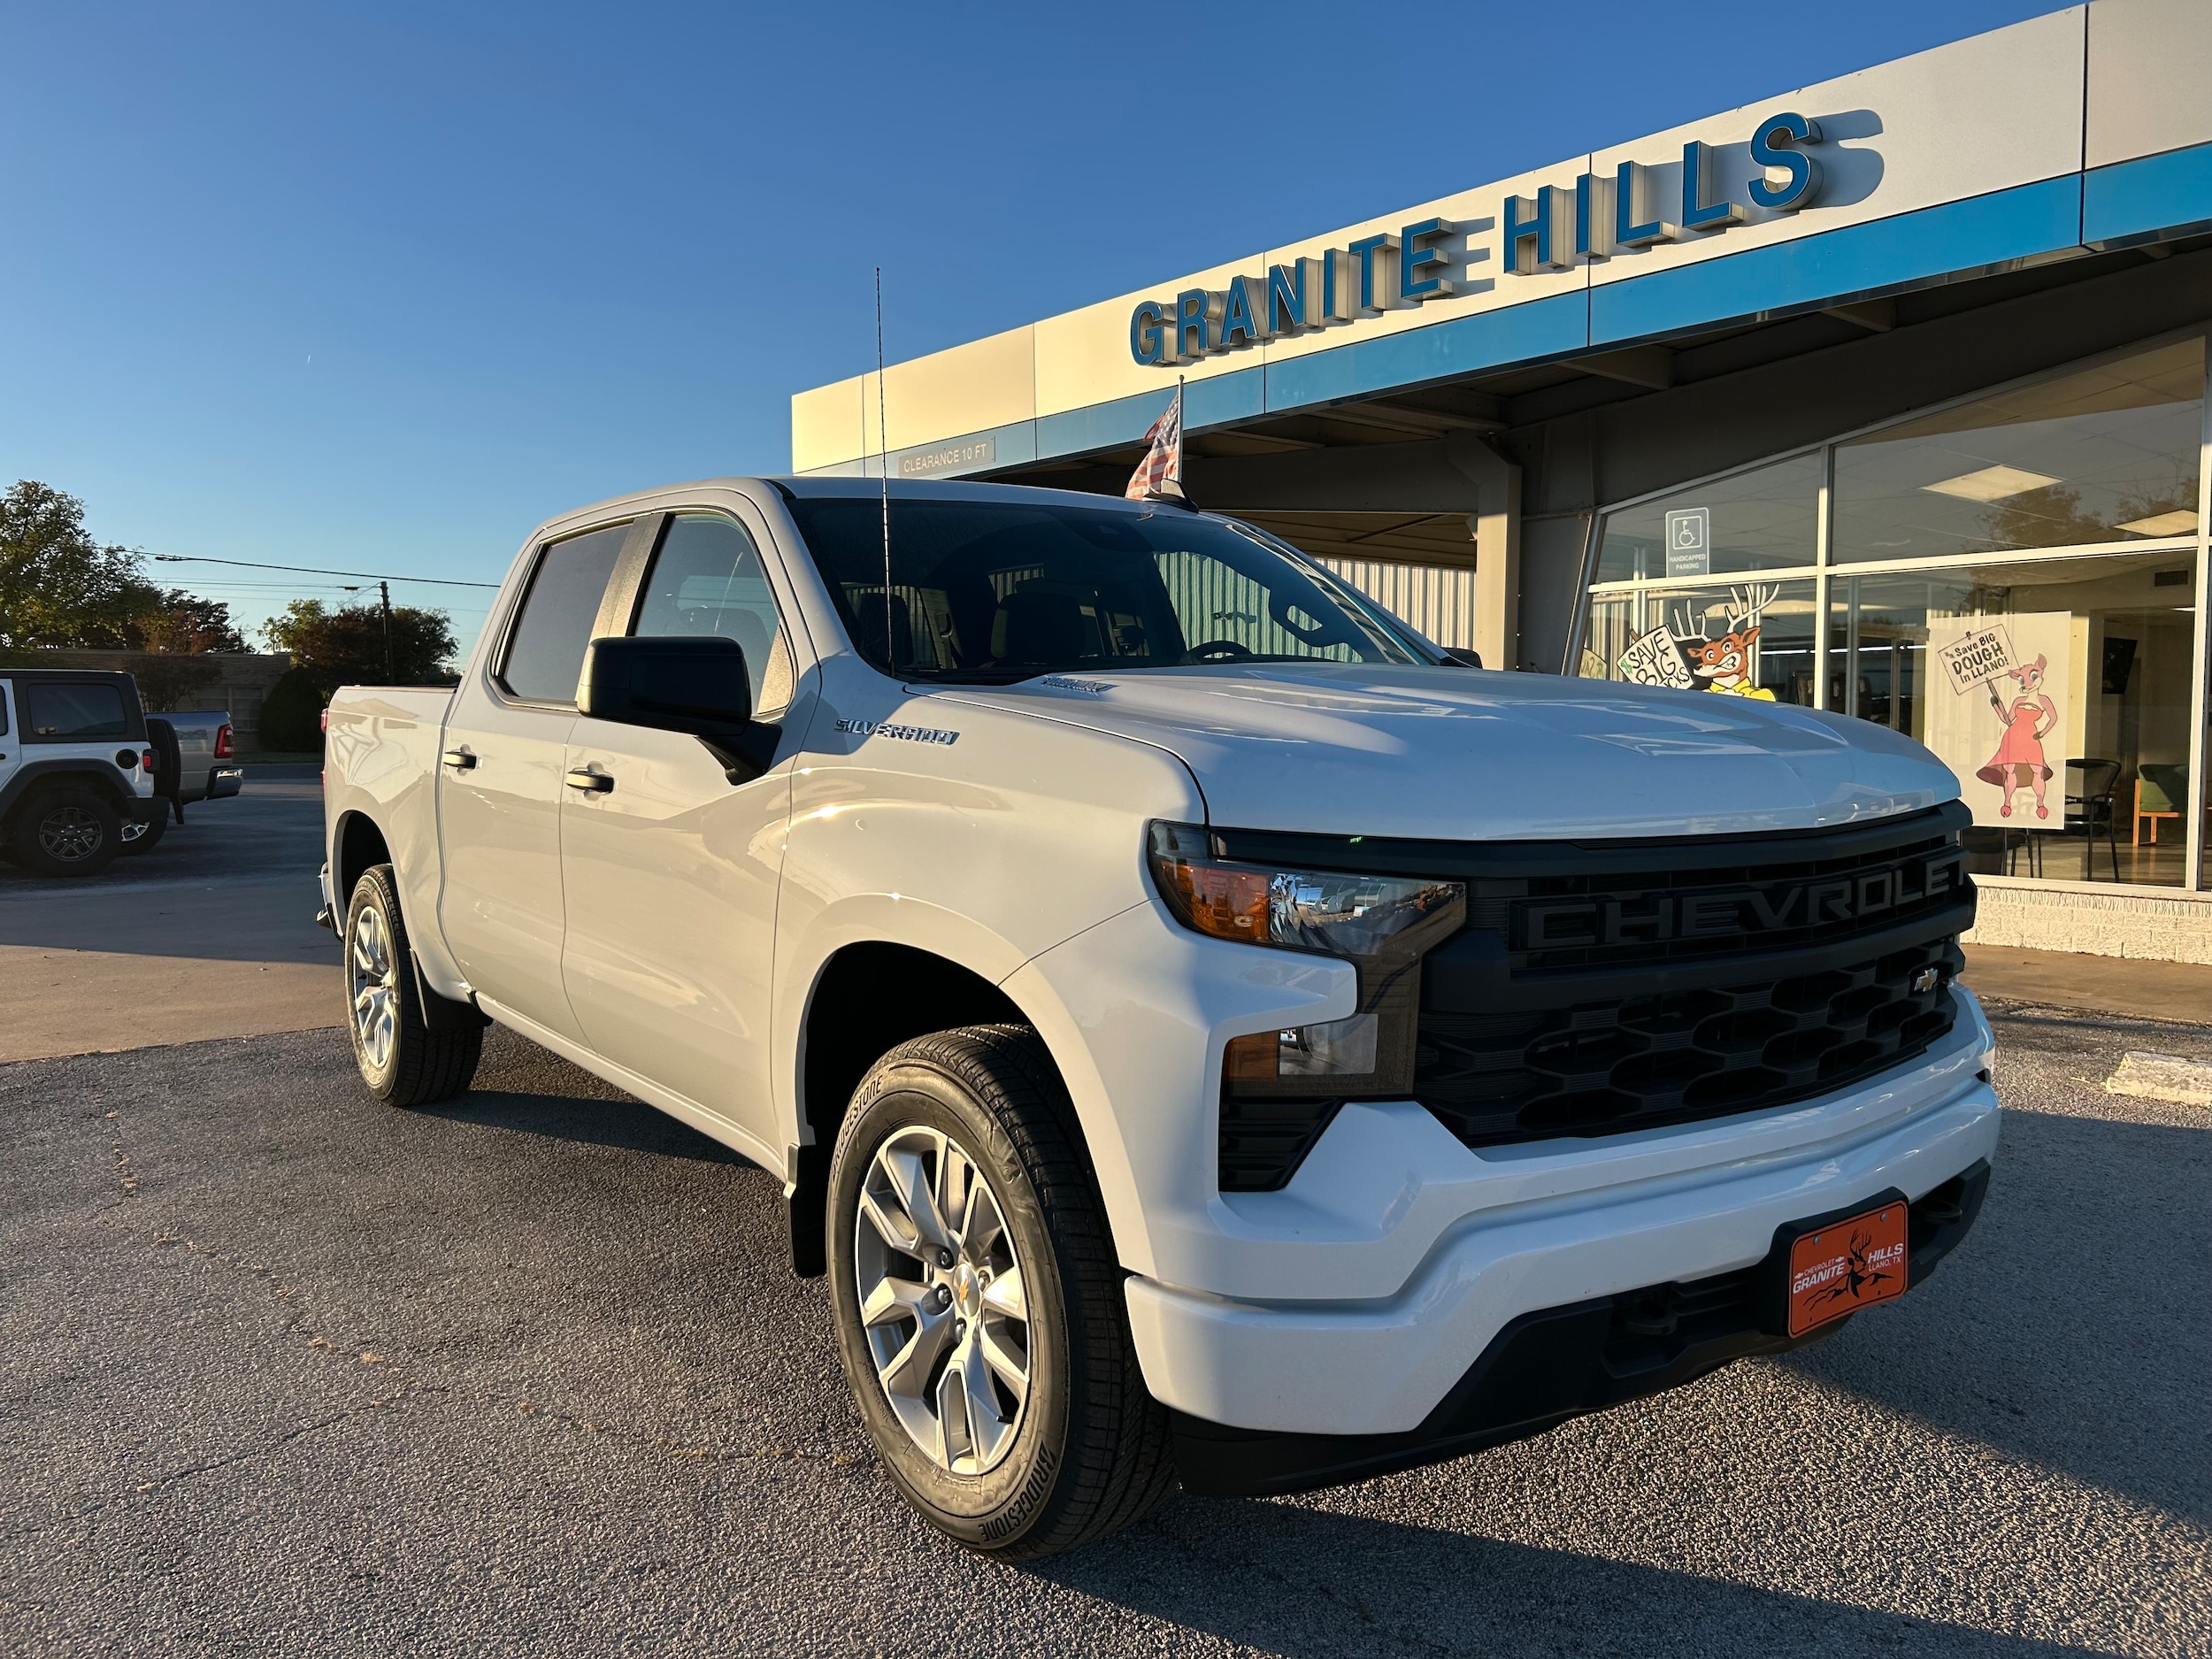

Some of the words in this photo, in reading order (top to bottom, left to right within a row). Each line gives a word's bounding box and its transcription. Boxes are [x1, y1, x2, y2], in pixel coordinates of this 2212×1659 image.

[1131, 218, 1448, 366] GRANITE
[1504, 111, 1819, 274] HILLS
[903, 449, 959, 472] CLEARANCE
[962, 447, 972, 461] 10
[975, 443, 987, 458] FT
[1669, 553, 1706, 563] HANDICAPPED
[1629, 631, 1670, 668] SAVE
[1952, 641, 2004, 675] DOUGH
[1955, 642, 1978, 657] Save
[1978, 633, 1996, 646] BIG
[1635, 652, 1676, 686] BIG
[1970, 656, 2009, 679] LLANO!
[834, 718, 960, 745] SILVERADO
[1520, 850, 1970, 950] CHEVROLET
[1793, 1262, 1845, 1294] GRANITE
[1868, 1242, 1904, 1263] HILLS
[1804, 1258, 1835, 1276] CHEVROLET
[1868, 1260, 1891, 1271] LLANO,
[1893, 1256, 1901, 1265] TX
[978, 1440, 1057, 1542] BRIDGESTONE
